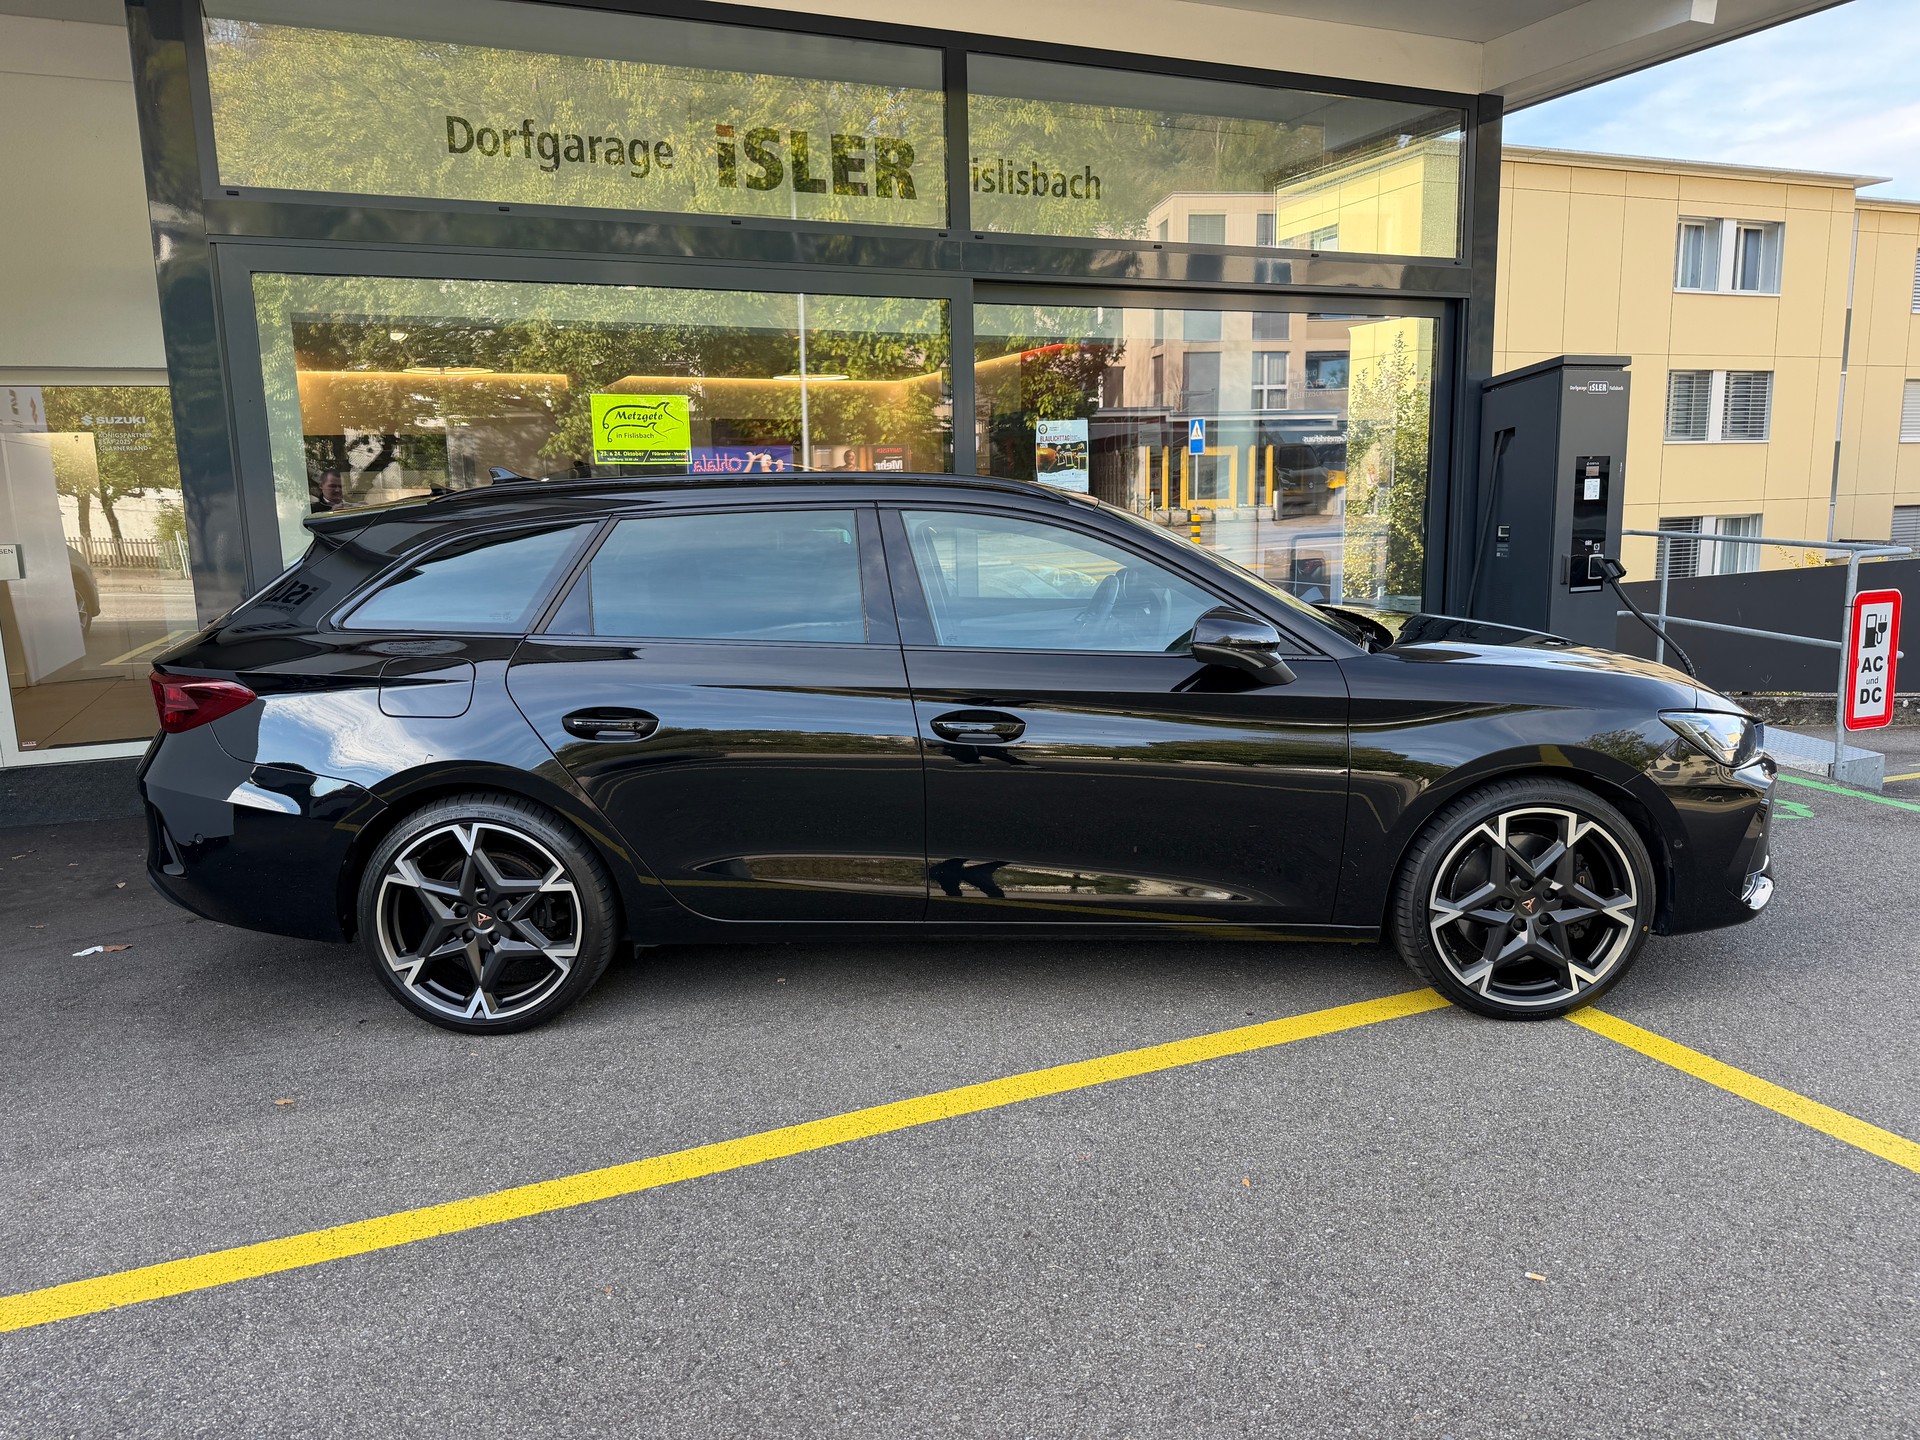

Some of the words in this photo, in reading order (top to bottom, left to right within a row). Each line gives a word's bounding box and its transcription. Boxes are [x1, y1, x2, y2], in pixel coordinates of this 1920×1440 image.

[445, 115, 674, 179] Dorfgarage
[715, 124, 918, 200] iSLER
[972, 157, 1101, 200] islisbach
[95, 416, 146, 425] SUZUKI
[614, 411, 663, 422] Metzgete
[1861, 655, 1883, 673] AC
[1865, 676, 1879, 685] und
[1860, 687, 1882, 705] DC
